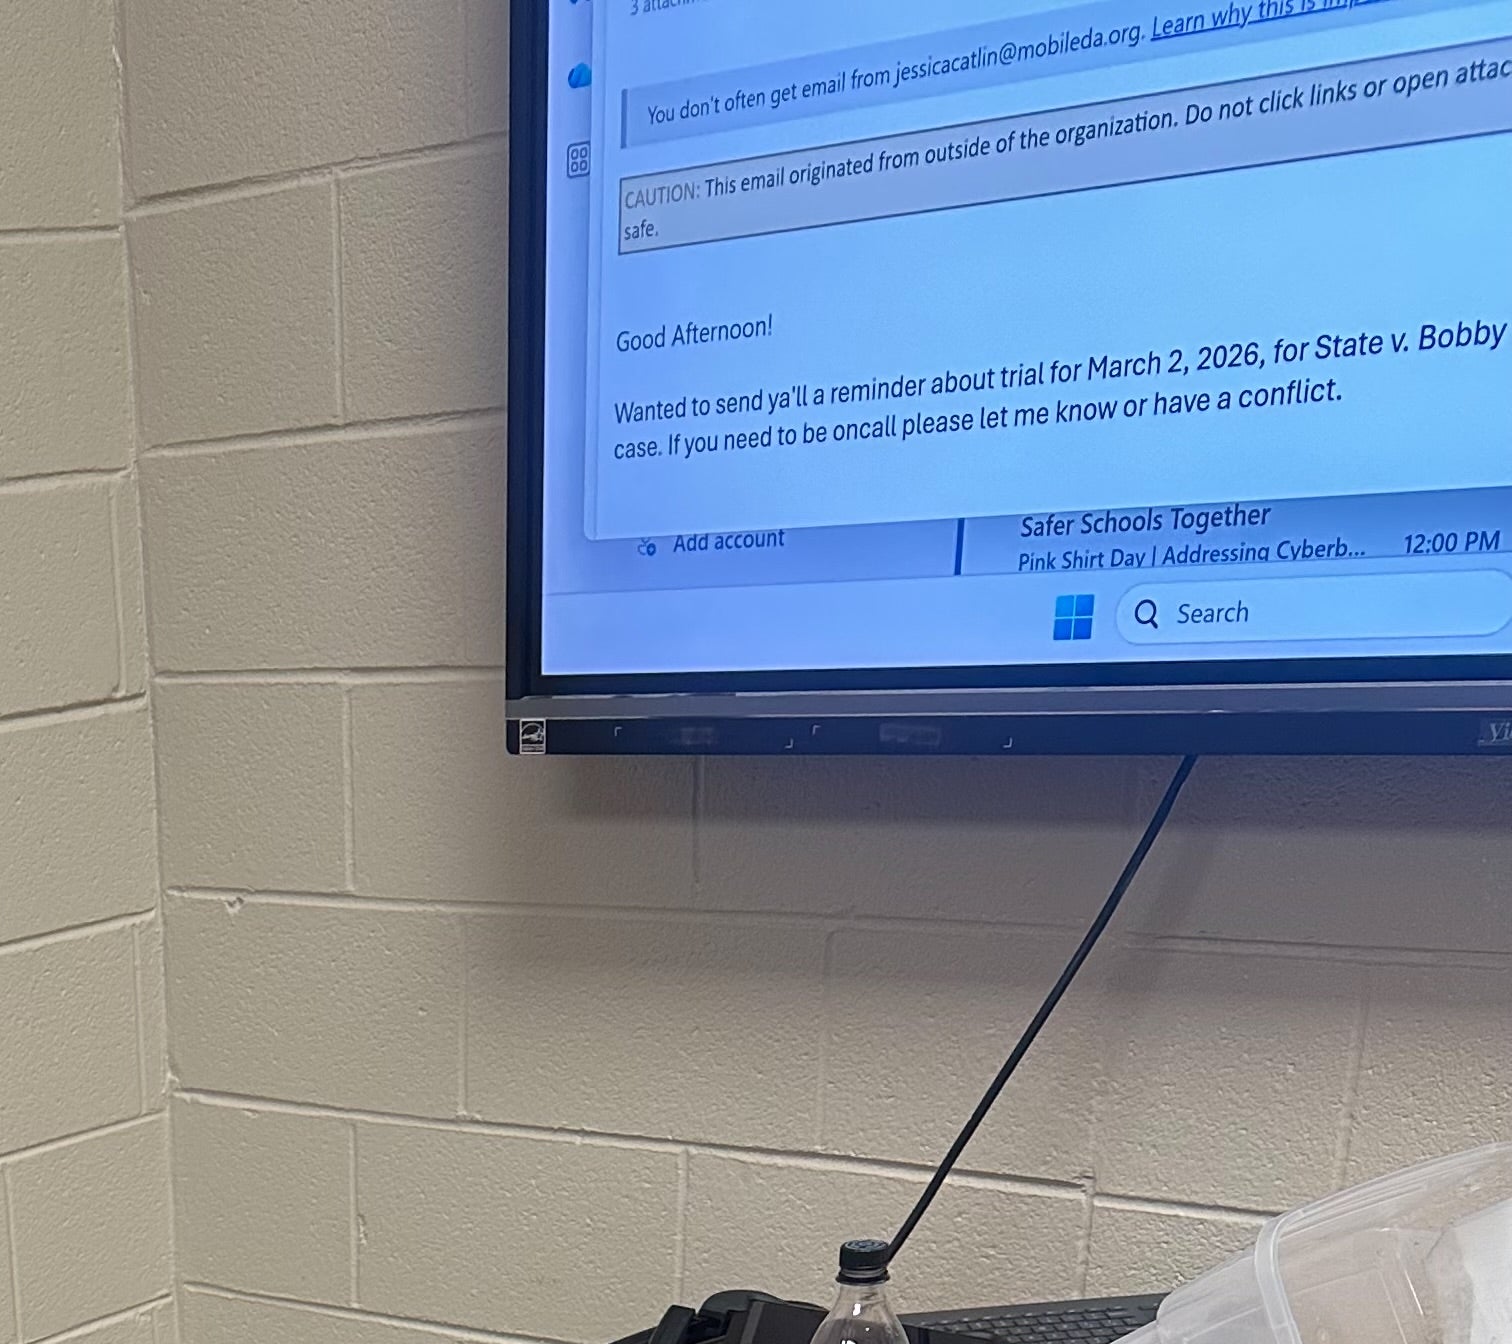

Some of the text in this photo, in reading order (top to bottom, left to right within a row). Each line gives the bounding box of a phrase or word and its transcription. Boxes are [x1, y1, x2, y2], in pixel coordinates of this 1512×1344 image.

[648, 106, 674, 125] You
[680, 95, 720, 119] don't
[725, 90, 765, 112] often
[771, 82, 797, 108] get
[802, 71, 845, 98] email
[851, 68, 890, 89] from
[893, 25, 1145, 88] jessicacatlin@mobileda.org.
[1152, 14, 1204, 40] Learn
[1212, 5, 1252, 29] why
[1260, 0, 1294, 19] this
[625, 58, 1512, 209] CAUTION: This email originated from outside of the organization. Do not click links or open attac
[624, 220, 659, 241] safe.
[616, 313, 773, 352] Good Afternoon!
[614, 319, 1508, 424] Wanted to send ya'll a reminder about trial for March 2, 2026, for State v. Bobby
[614, 378, 1343, 460] case. If you need to be oncall please let me know or have a conflict.
[1020, 503, 1272, 538] Safer Schools Together
[673, 529, 785, 553] Add account
[1403, 530, 1501, 555] 12:00 PM
[1018, 551, 1056, 572] Pink
[1061, 549, 1104, 570] Shirt
[1110, 547, 1146, 568] Day
[1176, 600, 1249, 625] Search
